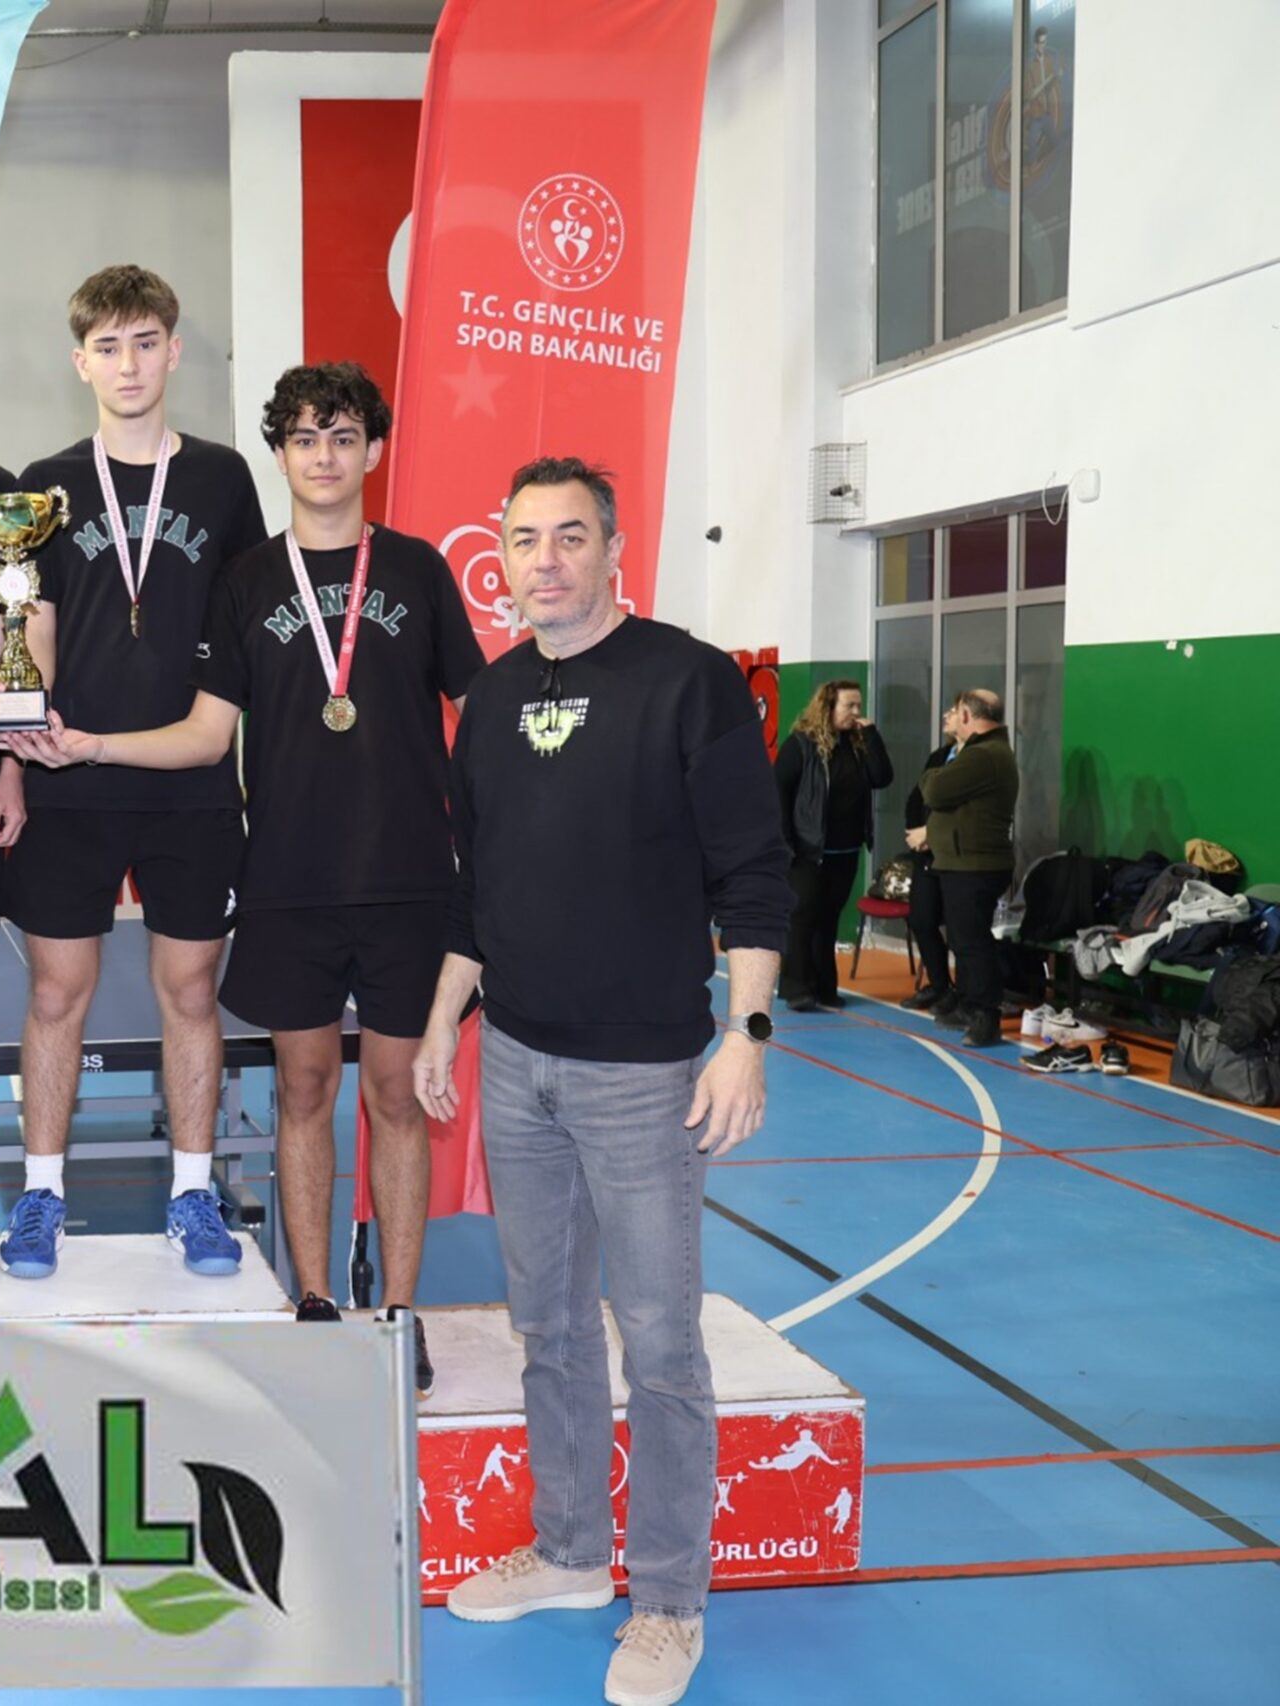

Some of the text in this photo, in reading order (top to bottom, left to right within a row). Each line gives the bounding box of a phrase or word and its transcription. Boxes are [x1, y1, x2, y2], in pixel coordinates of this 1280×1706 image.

[460, 291, 664, 342] T.C. GENÇLİK VE
[457, 324, 662, 374] SPOR BAKANLIĞI
[264, 583, 408, 644] MNAL
[420, 1553, 482, 1581] ÇLİK
[710, 1536, 818, 1561] ÜRLÜĞÜ
